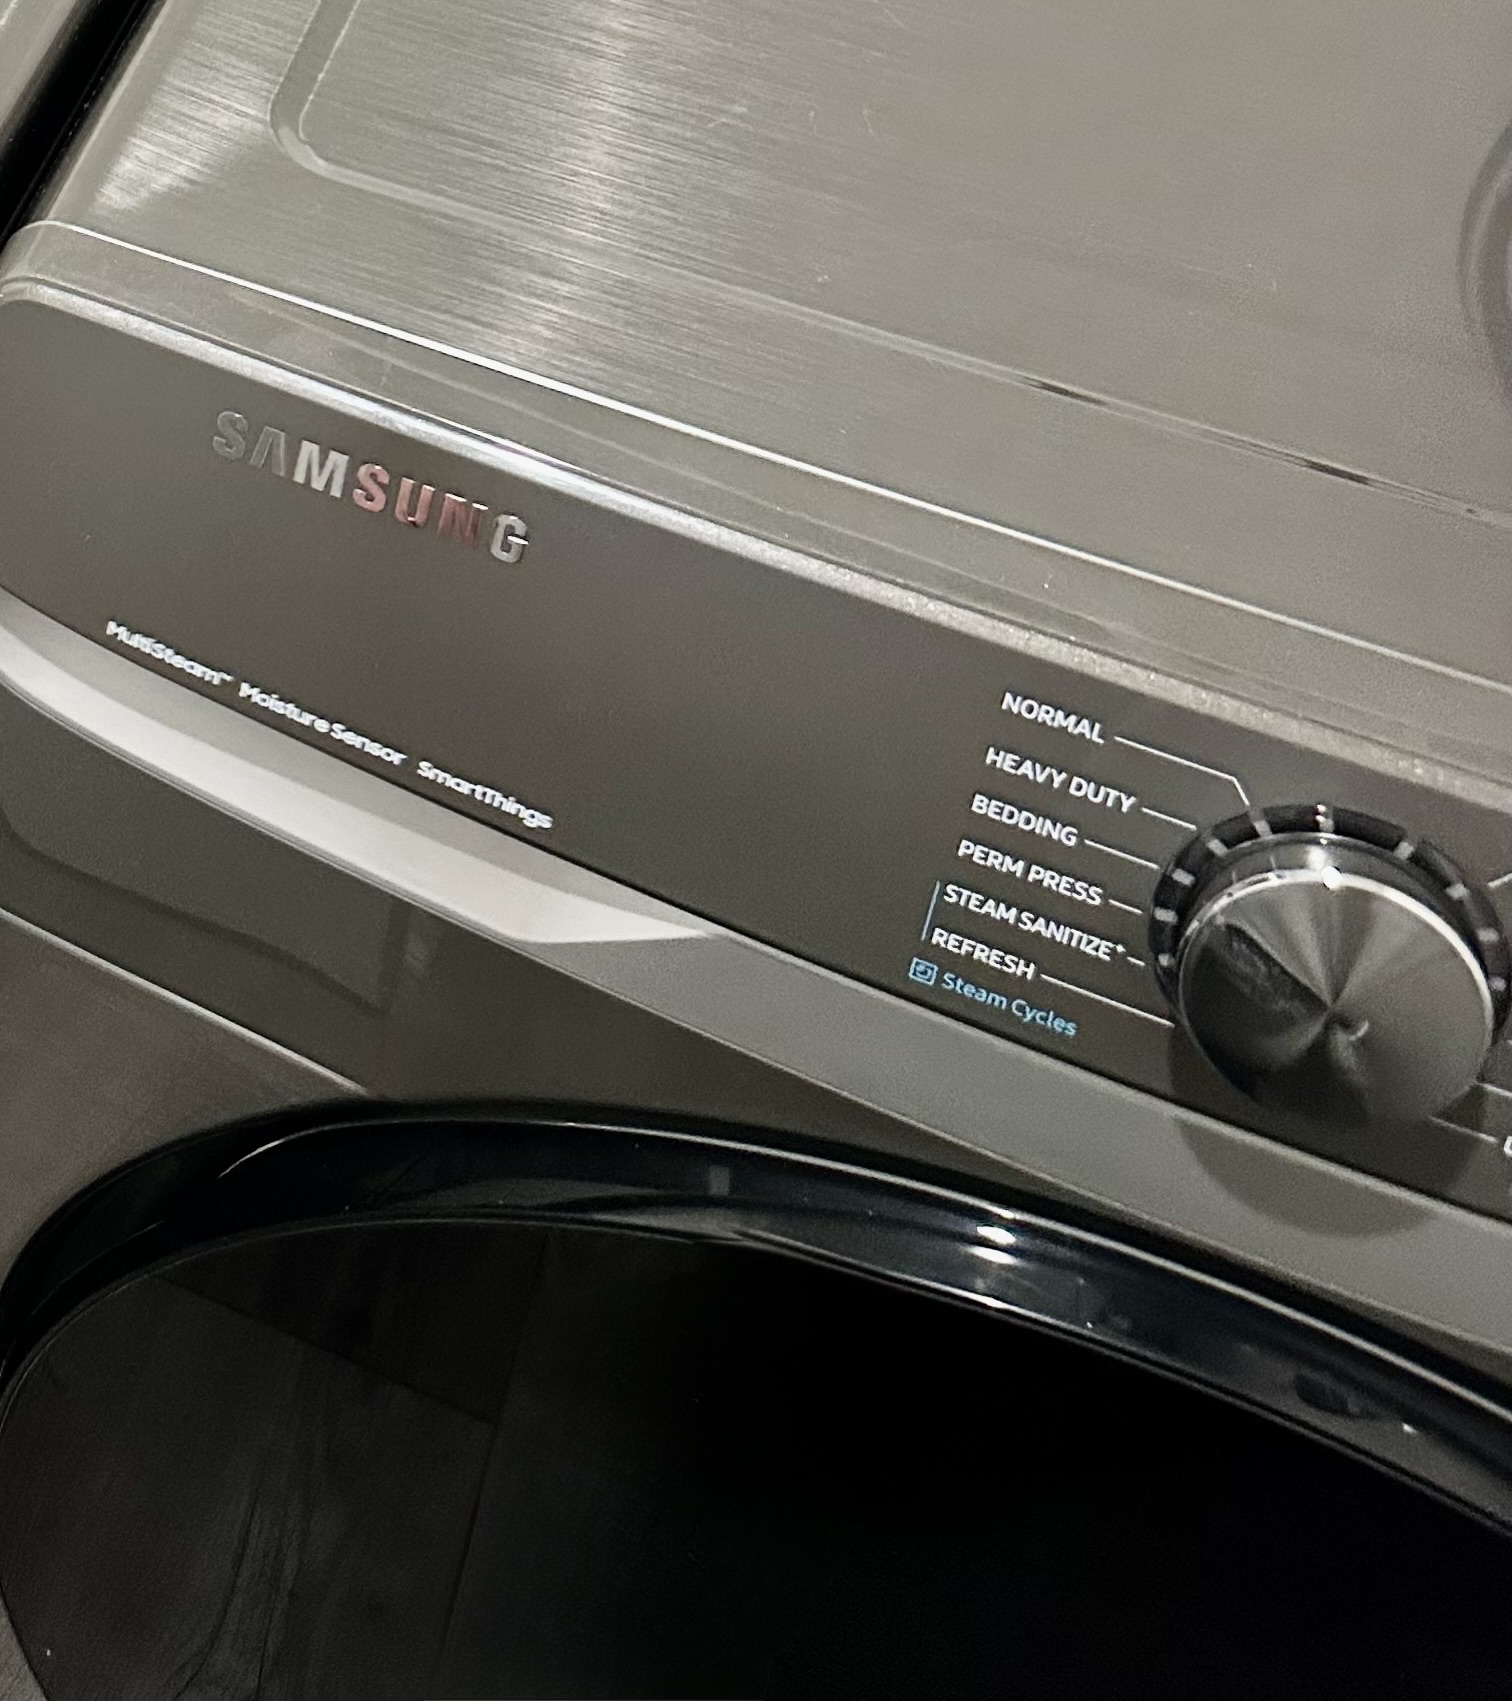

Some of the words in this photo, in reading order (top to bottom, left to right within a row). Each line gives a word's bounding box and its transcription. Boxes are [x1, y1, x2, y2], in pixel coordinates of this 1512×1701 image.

[213, 410, 529, 564] SAMSUNG
[1001, 691, 1105, 744] NORMAL
[239, 681, 331, 732] Moisture
[330, 722, 408, 766] Sensor
[417, 760, 554, 829] SmartThings
[985, 746, 1067, 789] HEAVY
[1068, 775, 1137, 813] DUTY
[970, 793, 1079, 847] BEDDING
[943, 883, 1018, 925] STEAM
[957, 839, 1025, 878] PERM
[1027, 864, 1104, 906] PRESS
[931, 927, 1037, 981] REFRESH
[941, 972, 1009, 1011] Steam
[1011, 999, 1080, 1039] Cycles
